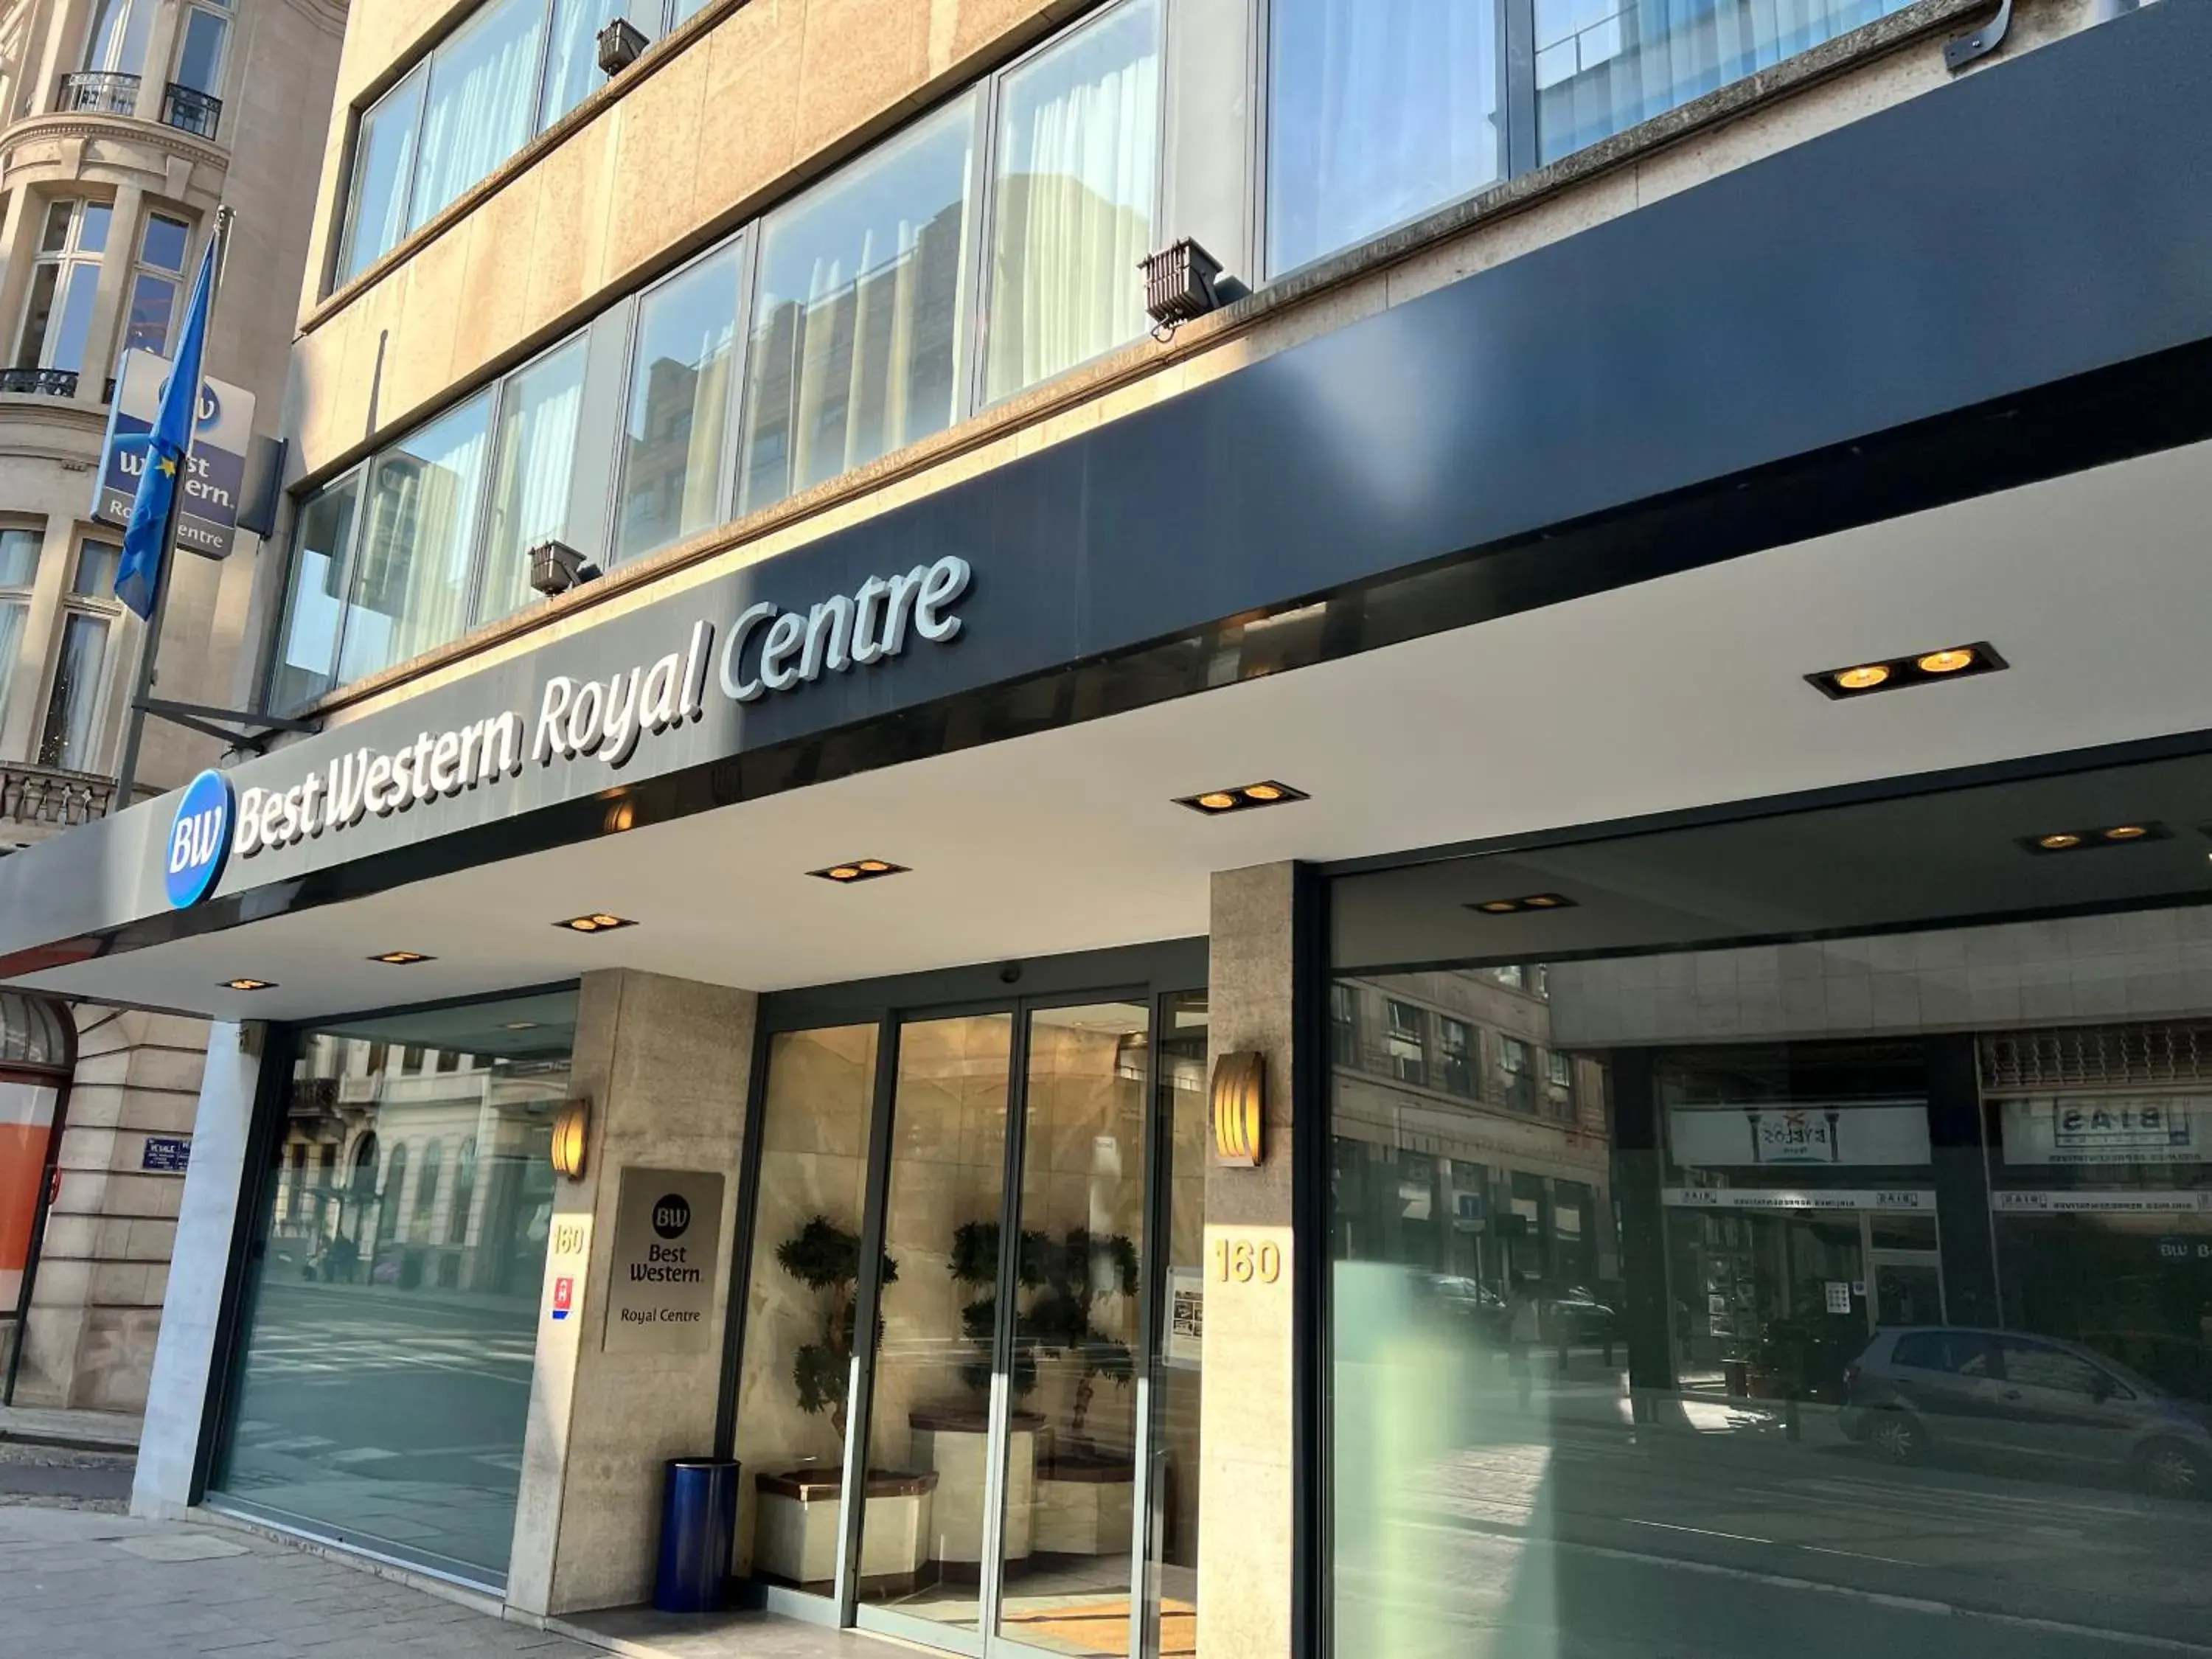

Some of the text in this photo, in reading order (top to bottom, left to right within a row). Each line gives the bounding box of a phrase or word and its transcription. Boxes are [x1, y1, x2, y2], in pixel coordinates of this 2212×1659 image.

[177, 522, 223, 548] entre
[170, 555, 972, 874] BW Best Western Royal Centre
[657, 1208, 687, 1227] BW
[554, 1225, 584, 1255] 160
[649, 1244, 687, 1263] Best
[1215, 1239, 1281, 1284] 160
[630, 1263, 700, 1283] Western
[621, 1309, 700, 1324] Royal Centre
